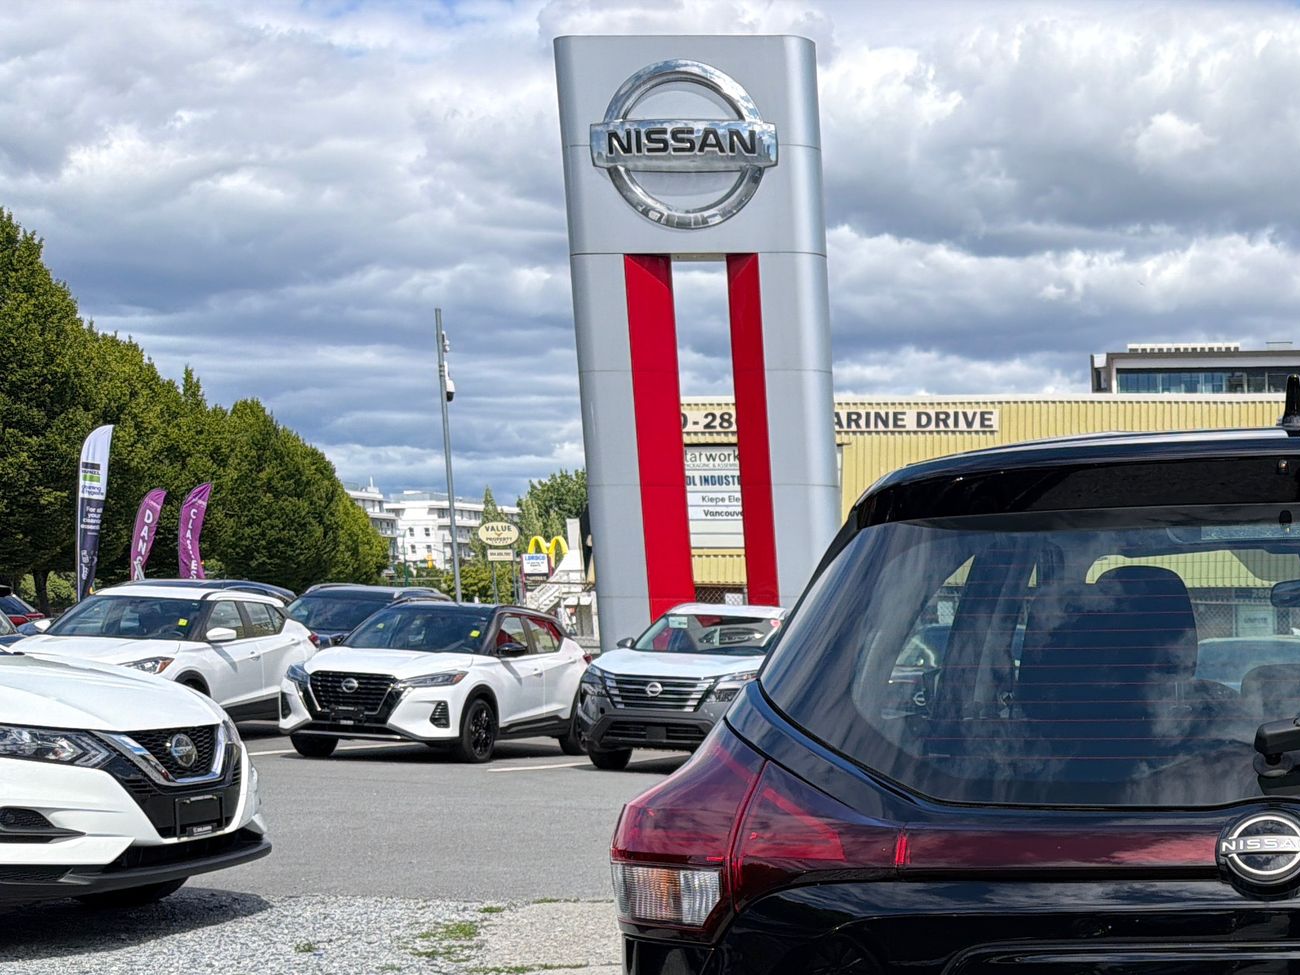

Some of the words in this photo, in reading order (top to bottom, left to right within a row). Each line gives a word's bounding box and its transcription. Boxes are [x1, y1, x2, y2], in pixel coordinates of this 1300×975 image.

[606, 127, 757, 157] NISSAN
[916, 411, 994, 429] DRIVE
[701, 495, 726, 504] Kiepe
